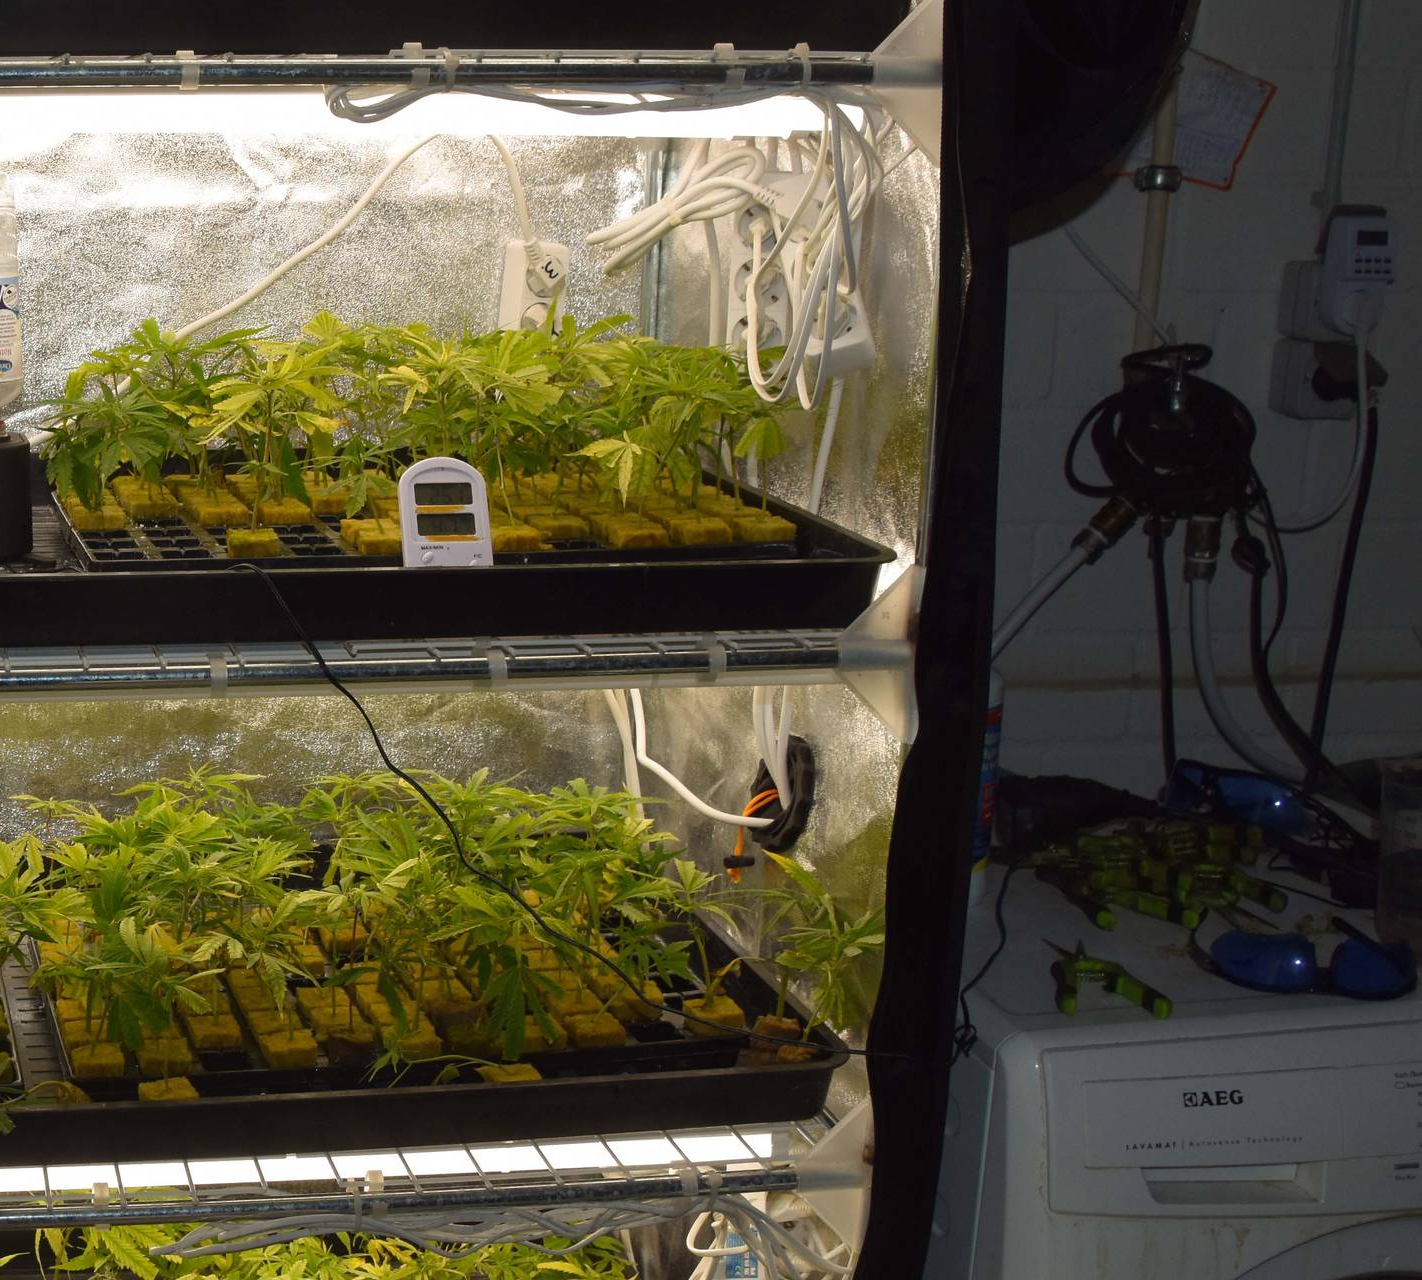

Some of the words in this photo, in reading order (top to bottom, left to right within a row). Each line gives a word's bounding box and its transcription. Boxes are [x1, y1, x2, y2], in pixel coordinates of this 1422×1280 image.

[1199, 1089, 1244, 1107] AEG
[1126, 1142, 1177, 1151] LAVAMAT
[1246, 1136, 1304, 1145] Technology
